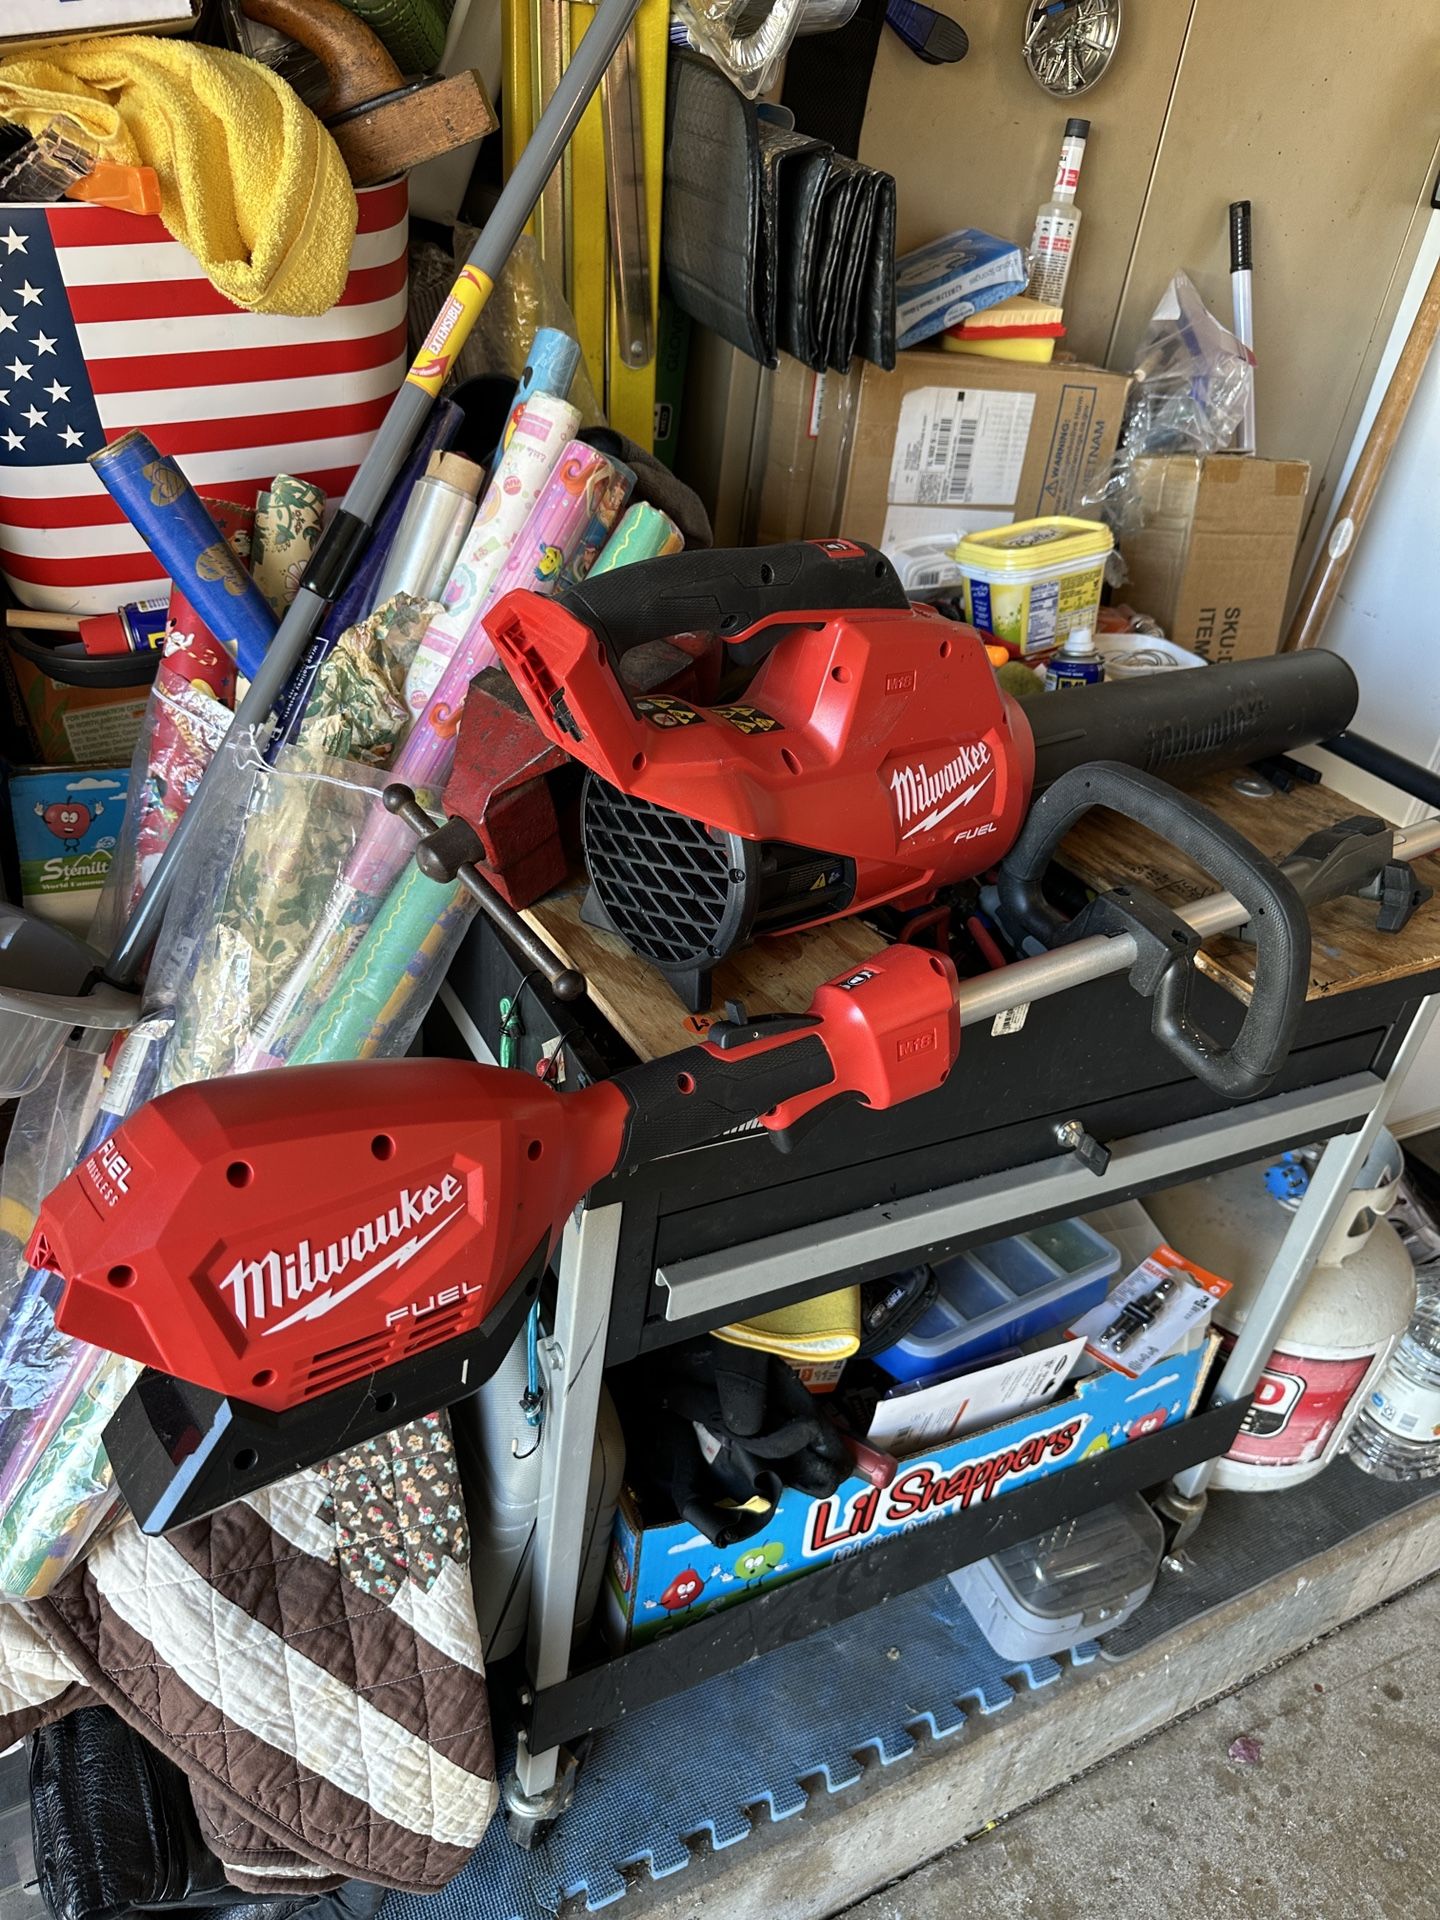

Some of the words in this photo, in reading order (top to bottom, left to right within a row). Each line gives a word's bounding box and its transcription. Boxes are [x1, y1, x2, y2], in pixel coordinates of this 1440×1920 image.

[428, 299, 465, 356] EXTENSIBLE
[1052, 419, 1071, 478] WARNING:
[295, 665, 310, 690] holiday
[66, 714, 82, 723] FOR
[83, 708, 125, 720] INFORMATION
[890, 740, 991, 827] Milwaukee
[954, 822, 997, 844] FUEL
[40, 857, 109, 881] Stemilt
[42, 882, 69, 890] World
[899, 1038, 932, 1057] M18
[86, 1157, 119, 1207] BRUSHLESS
[98, 1138, 132, 1194] FUEL
[219, 1173, 462, 1329] Milwaukee
[386, 1281, 482, 1327] FUEL
[811, 1488, 881, 1551] Lil
[886, 1420, 1083, 1520] Snappers
